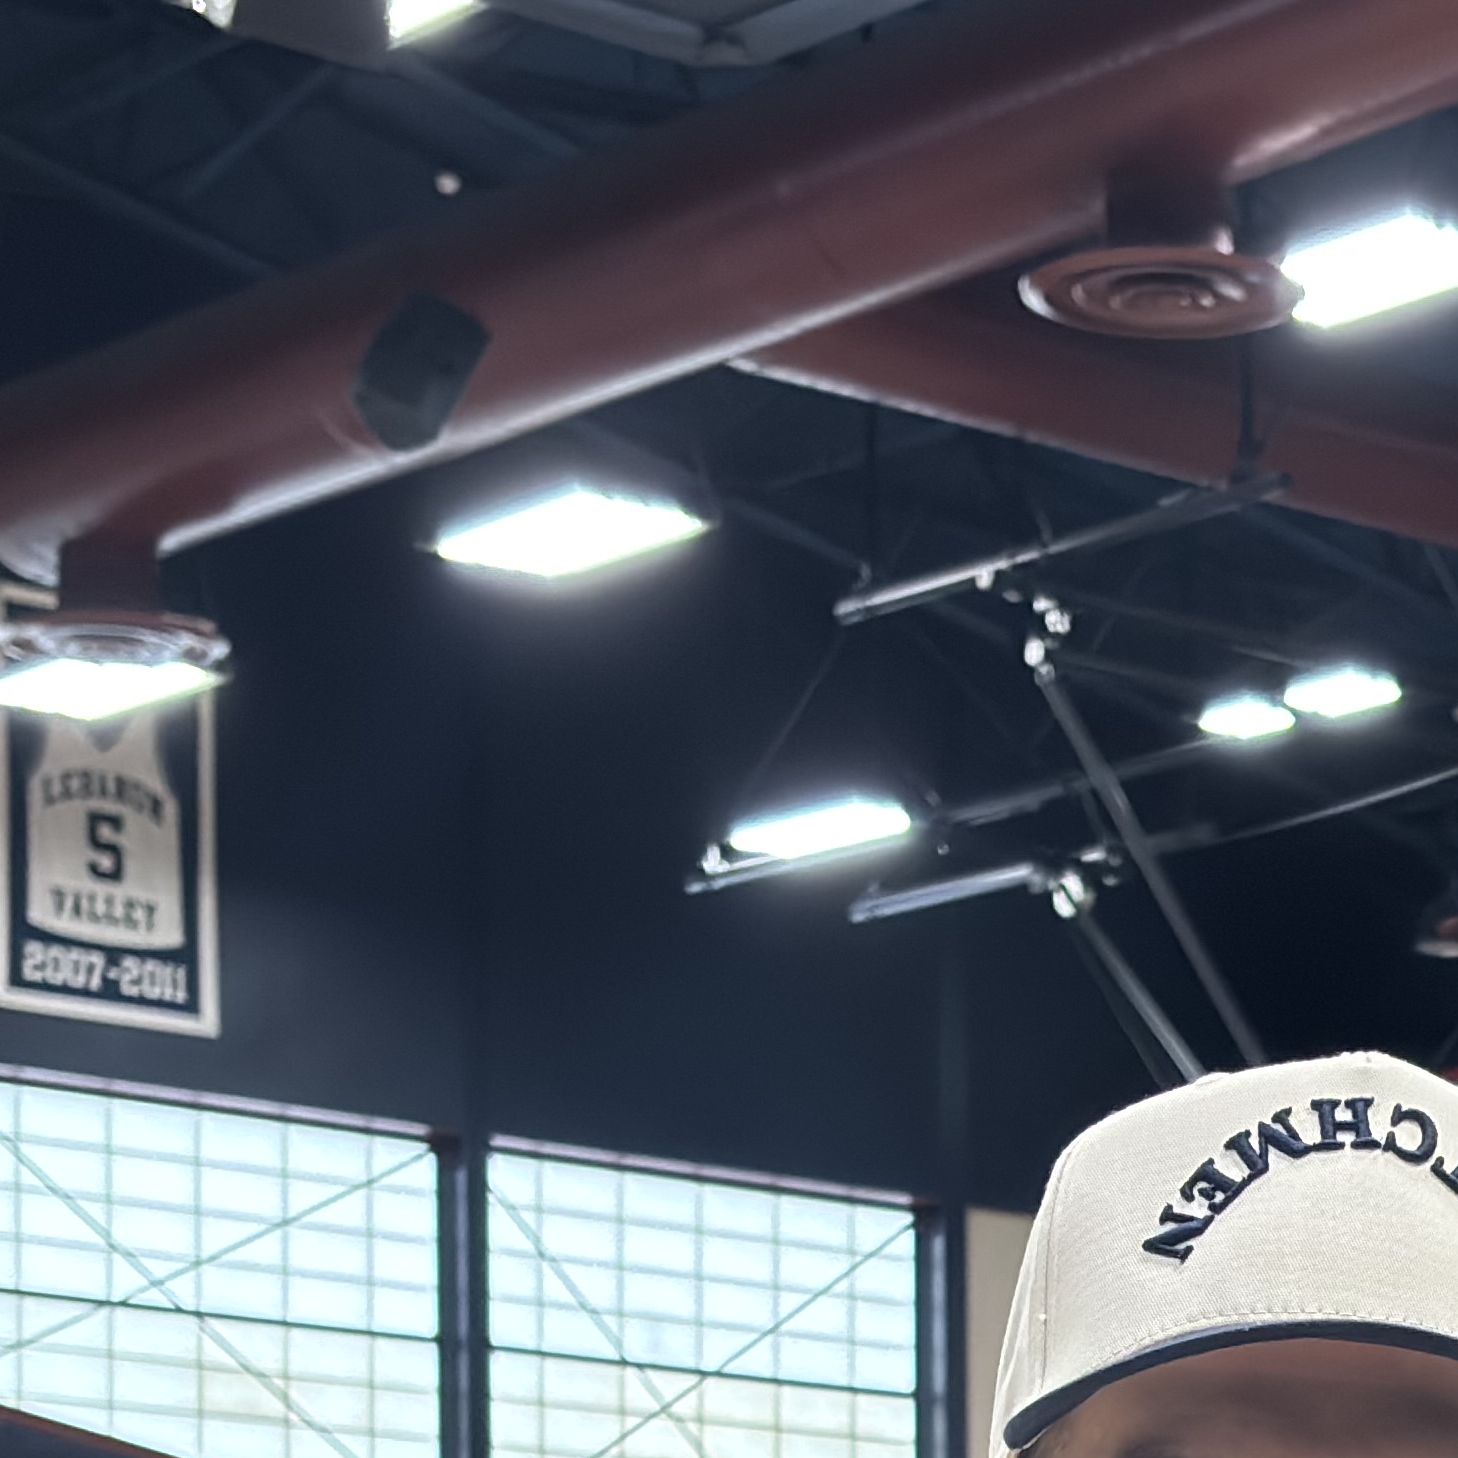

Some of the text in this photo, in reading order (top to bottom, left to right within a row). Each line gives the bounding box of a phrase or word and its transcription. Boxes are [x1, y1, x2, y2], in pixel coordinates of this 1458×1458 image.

[42, 768, 165, 828] LEBANON
[87, 809, 123, 882] 5
[49, 886, 159, 932] VALLEY
[21, 939, 188, 1004] 2007-2011
